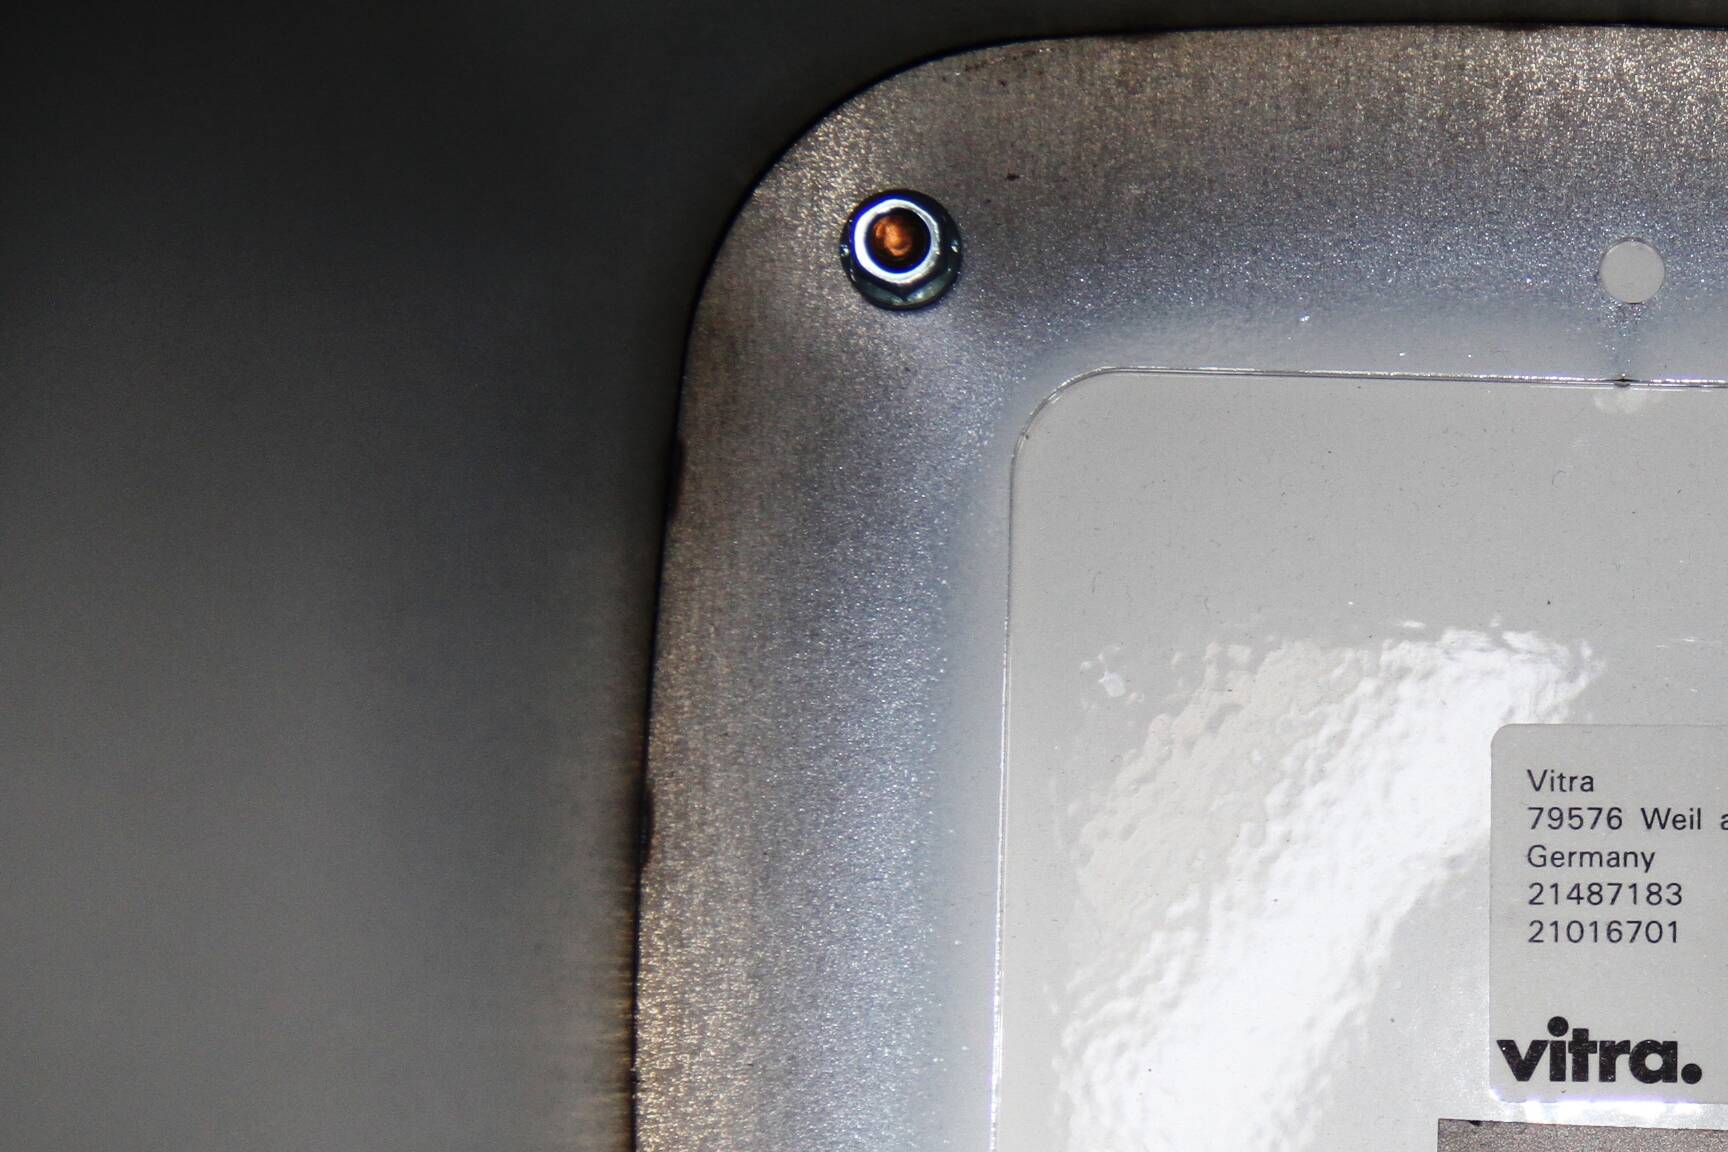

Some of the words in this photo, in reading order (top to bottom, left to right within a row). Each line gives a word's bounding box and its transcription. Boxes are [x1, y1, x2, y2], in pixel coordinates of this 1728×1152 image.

[1526, 769, 1595, 793] Vitra
[1528, 806, 1623, 831] 79576
[1640, 807, 1702, 831] Weil
[1526, 844, 1656, 874] Germany
[1528, 882, 1683, 907] 21487183
[1528, 919, 1677, 944] 21016701
[1496, 1015, 1703, 1085] vitra.
